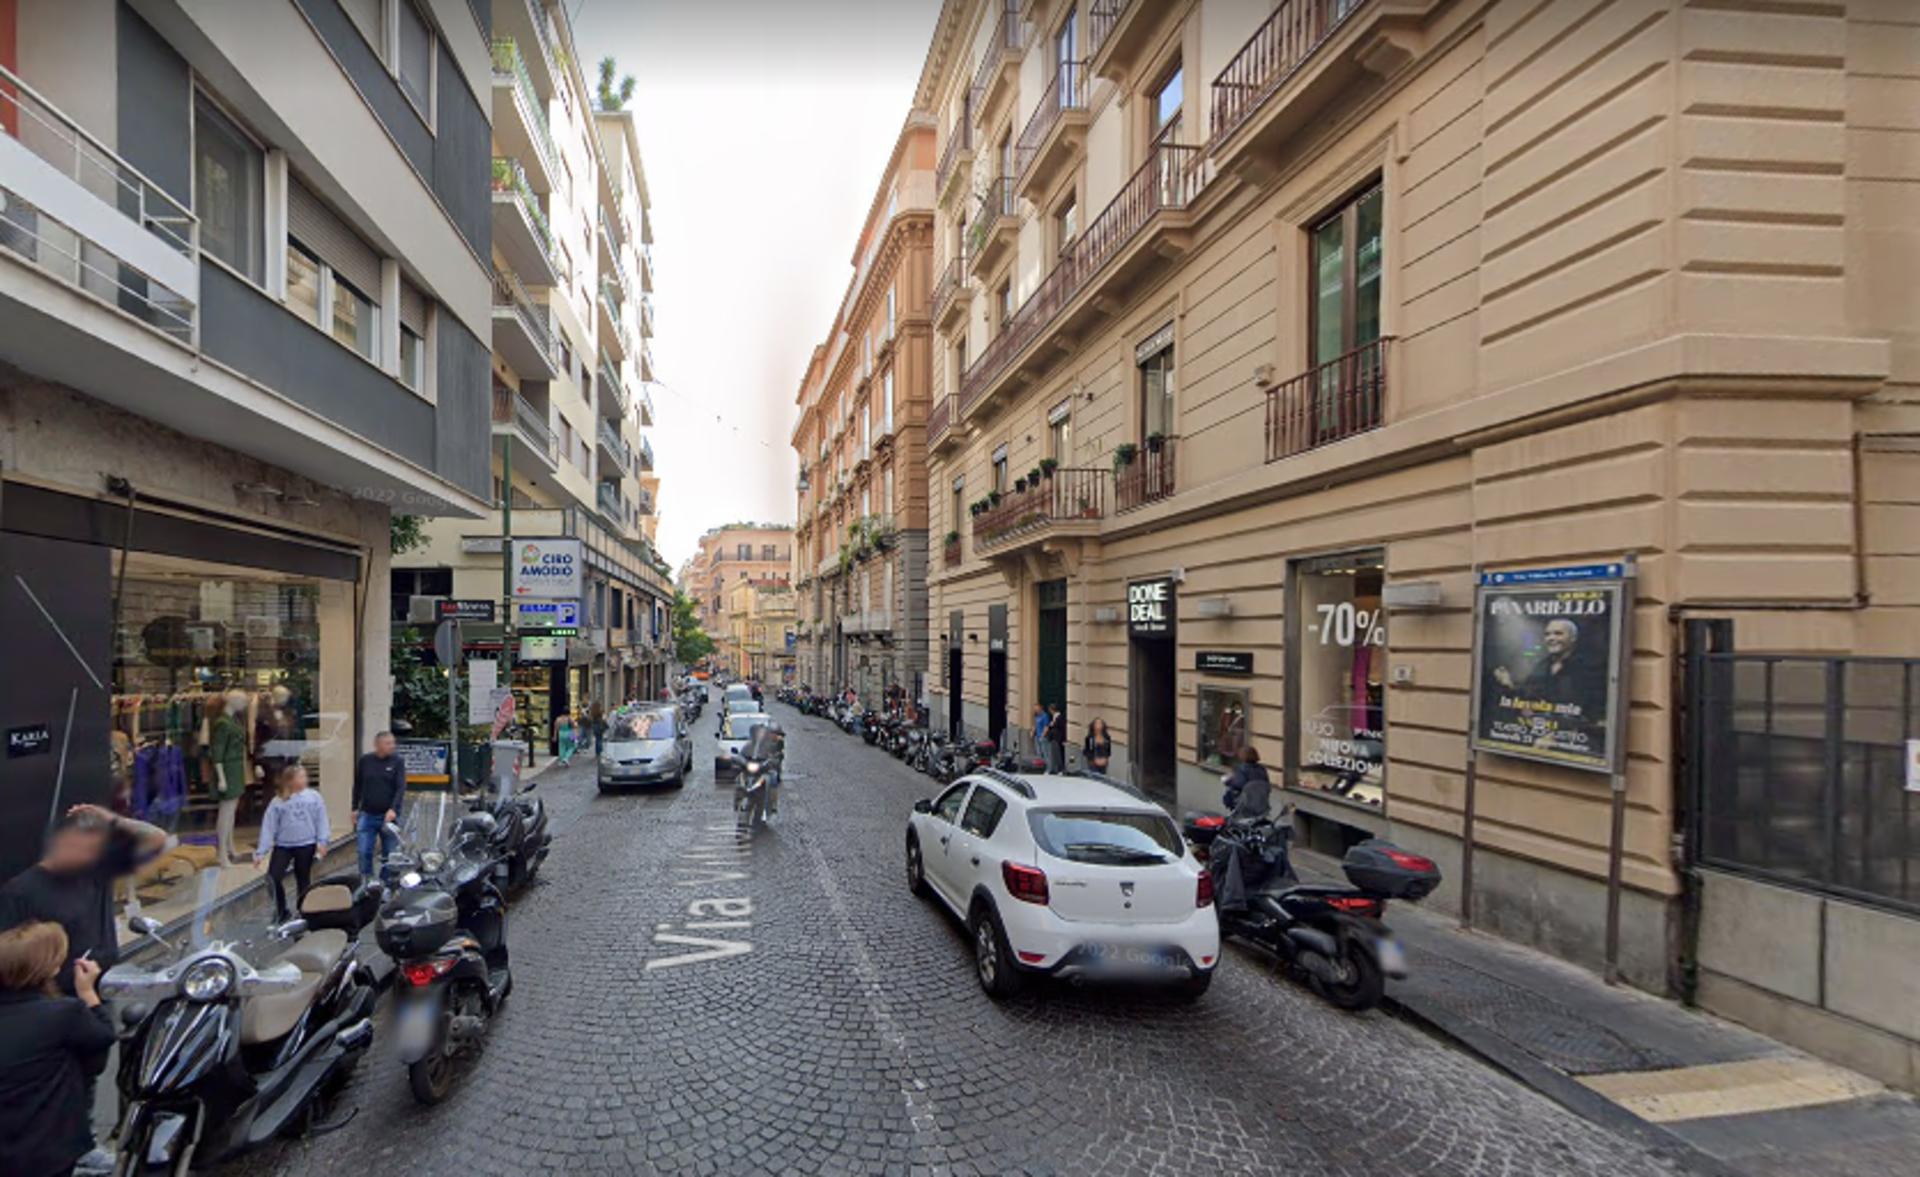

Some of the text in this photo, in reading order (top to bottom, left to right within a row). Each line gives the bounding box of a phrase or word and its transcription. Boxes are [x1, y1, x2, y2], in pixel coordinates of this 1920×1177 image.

[542, 553, 573, 564] CIRO
[521, 565, 573, 576] AMODIO
[1129, 583, 1168, 602] DONE
[1131, 602, 1167, 621] DEAL
[1308, 602, 1385, 647] -70%
[1320, 739, 1370, 758] NUOVA
